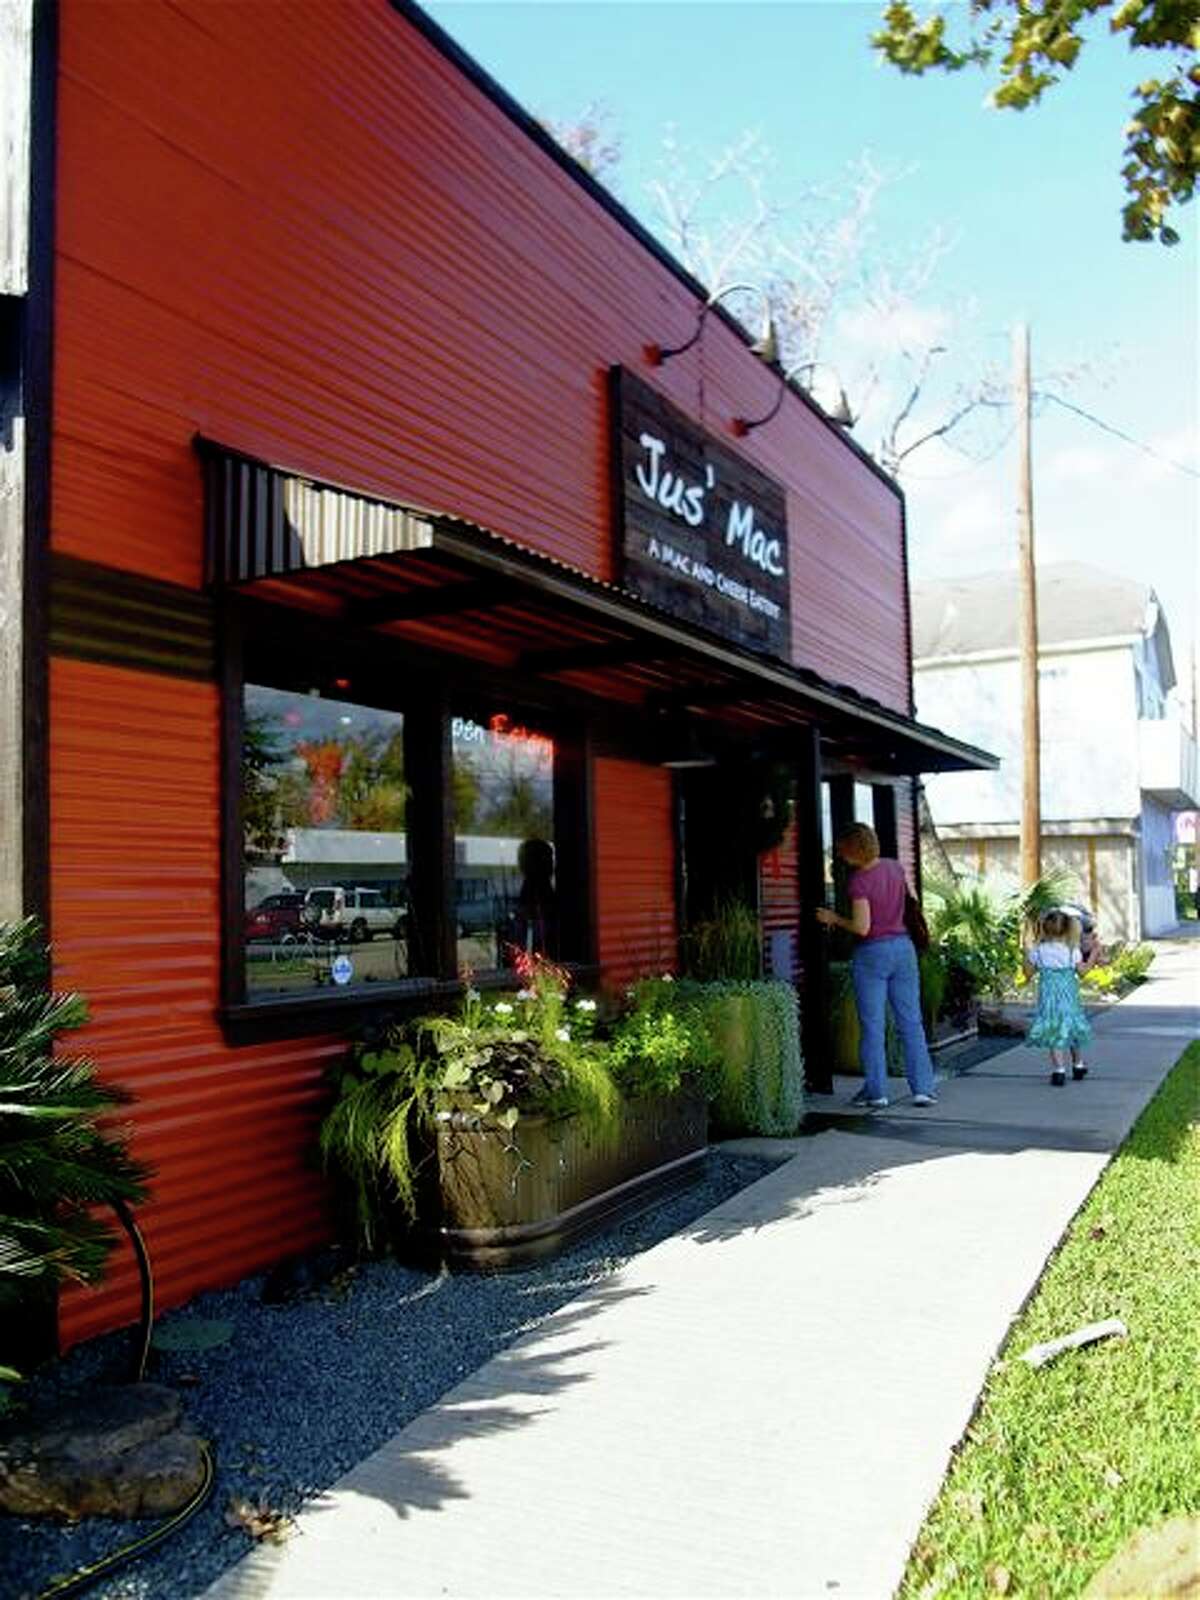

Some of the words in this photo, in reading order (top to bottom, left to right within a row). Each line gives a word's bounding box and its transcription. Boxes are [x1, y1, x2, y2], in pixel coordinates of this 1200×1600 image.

[636, 433, 714, 526] Jus'
[726, 501, 784, 575] Mac
[649, 539, 660, 559] A
[661, 544, 690, 574] MAC
